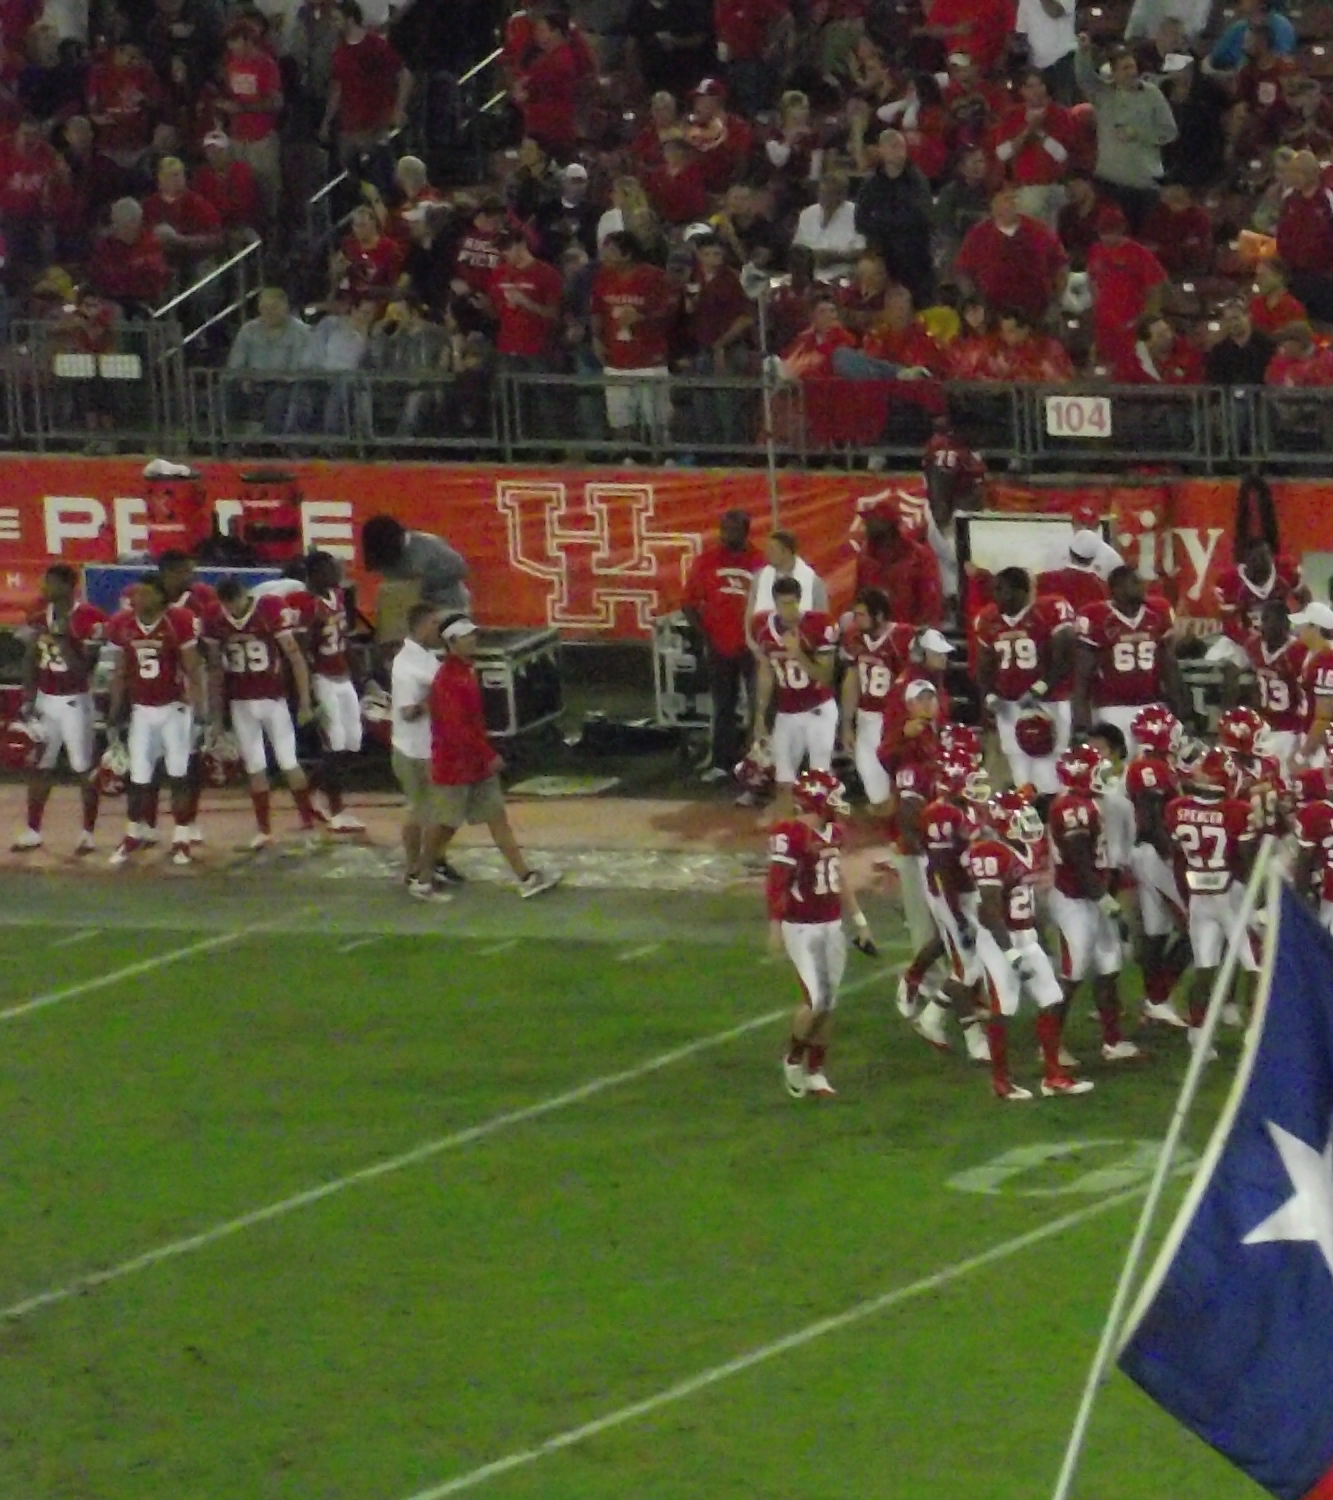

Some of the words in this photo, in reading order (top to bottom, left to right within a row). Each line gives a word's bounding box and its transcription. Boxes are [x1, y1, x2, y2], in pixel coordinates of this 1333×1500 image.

[1051, 401, 1107, 433] 104
[135, 648, 161, 679] 5
[994, 638, 1038, 670] 79
[1177, 808, 1224, 826] SPENCER
[1175, 825, 1228, 869] 27
